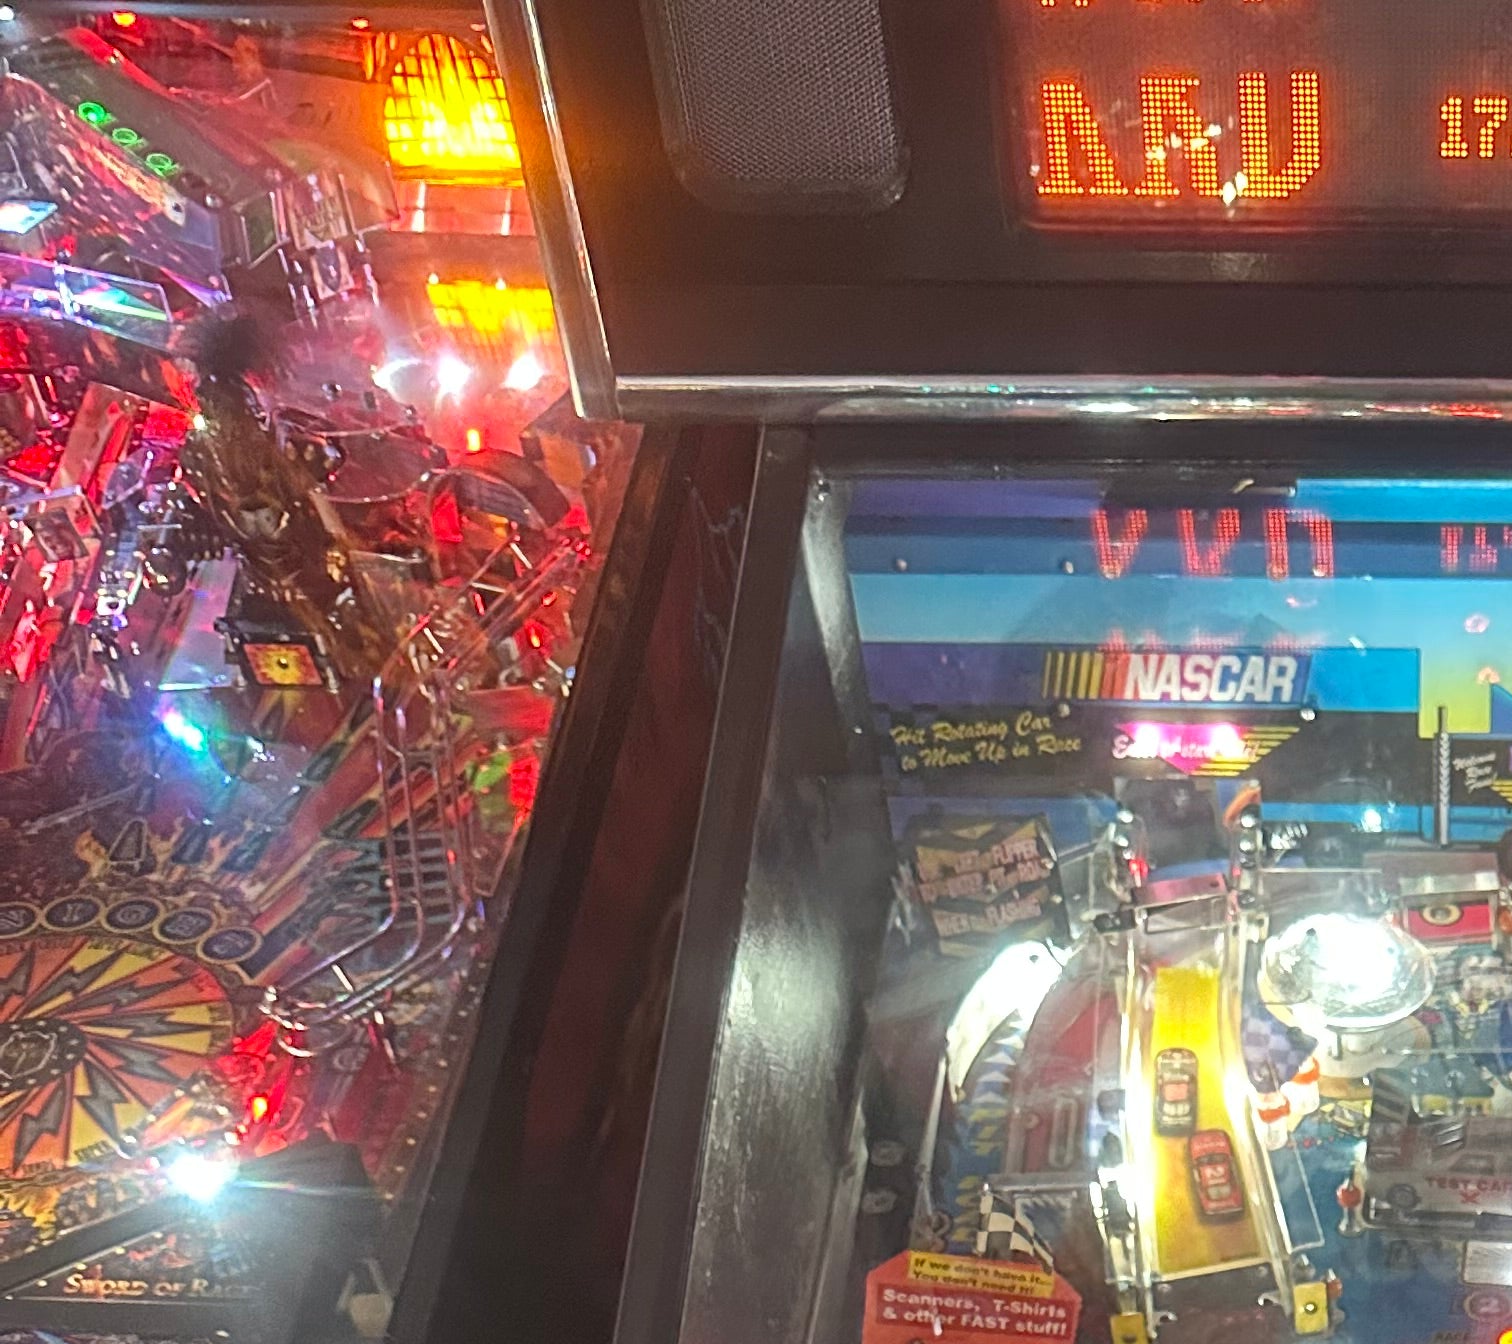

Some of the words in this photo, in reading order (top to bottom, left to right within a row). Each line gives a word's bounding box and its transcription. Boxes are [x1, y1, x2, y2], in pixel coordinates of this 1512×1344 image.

[1125, 655, 1297, 702] NASCAR
[931, 722, 1008, 741] Rotating
[1015, 711, 1051, 736] Car
[920, 747, 971, 767] Move
[1012, 742, 1029, 757] in
[913, 1269, 940, 1282] You
[914, 1258, 925, 1268] If
[929, 1262, 950, 1271] we
[993, 1268, 1027, 1282] have
[883, 1288, 981, 1312] Scanners,
[993, 1299, 1067, 1319] T-Shirts
[883, 1306, 897, 1320] &
[903, 1308, 955, 1325] other
[961, 1314, 1010, 1330] FAST
[1016, 1319, 1067, 1336] stuff!
